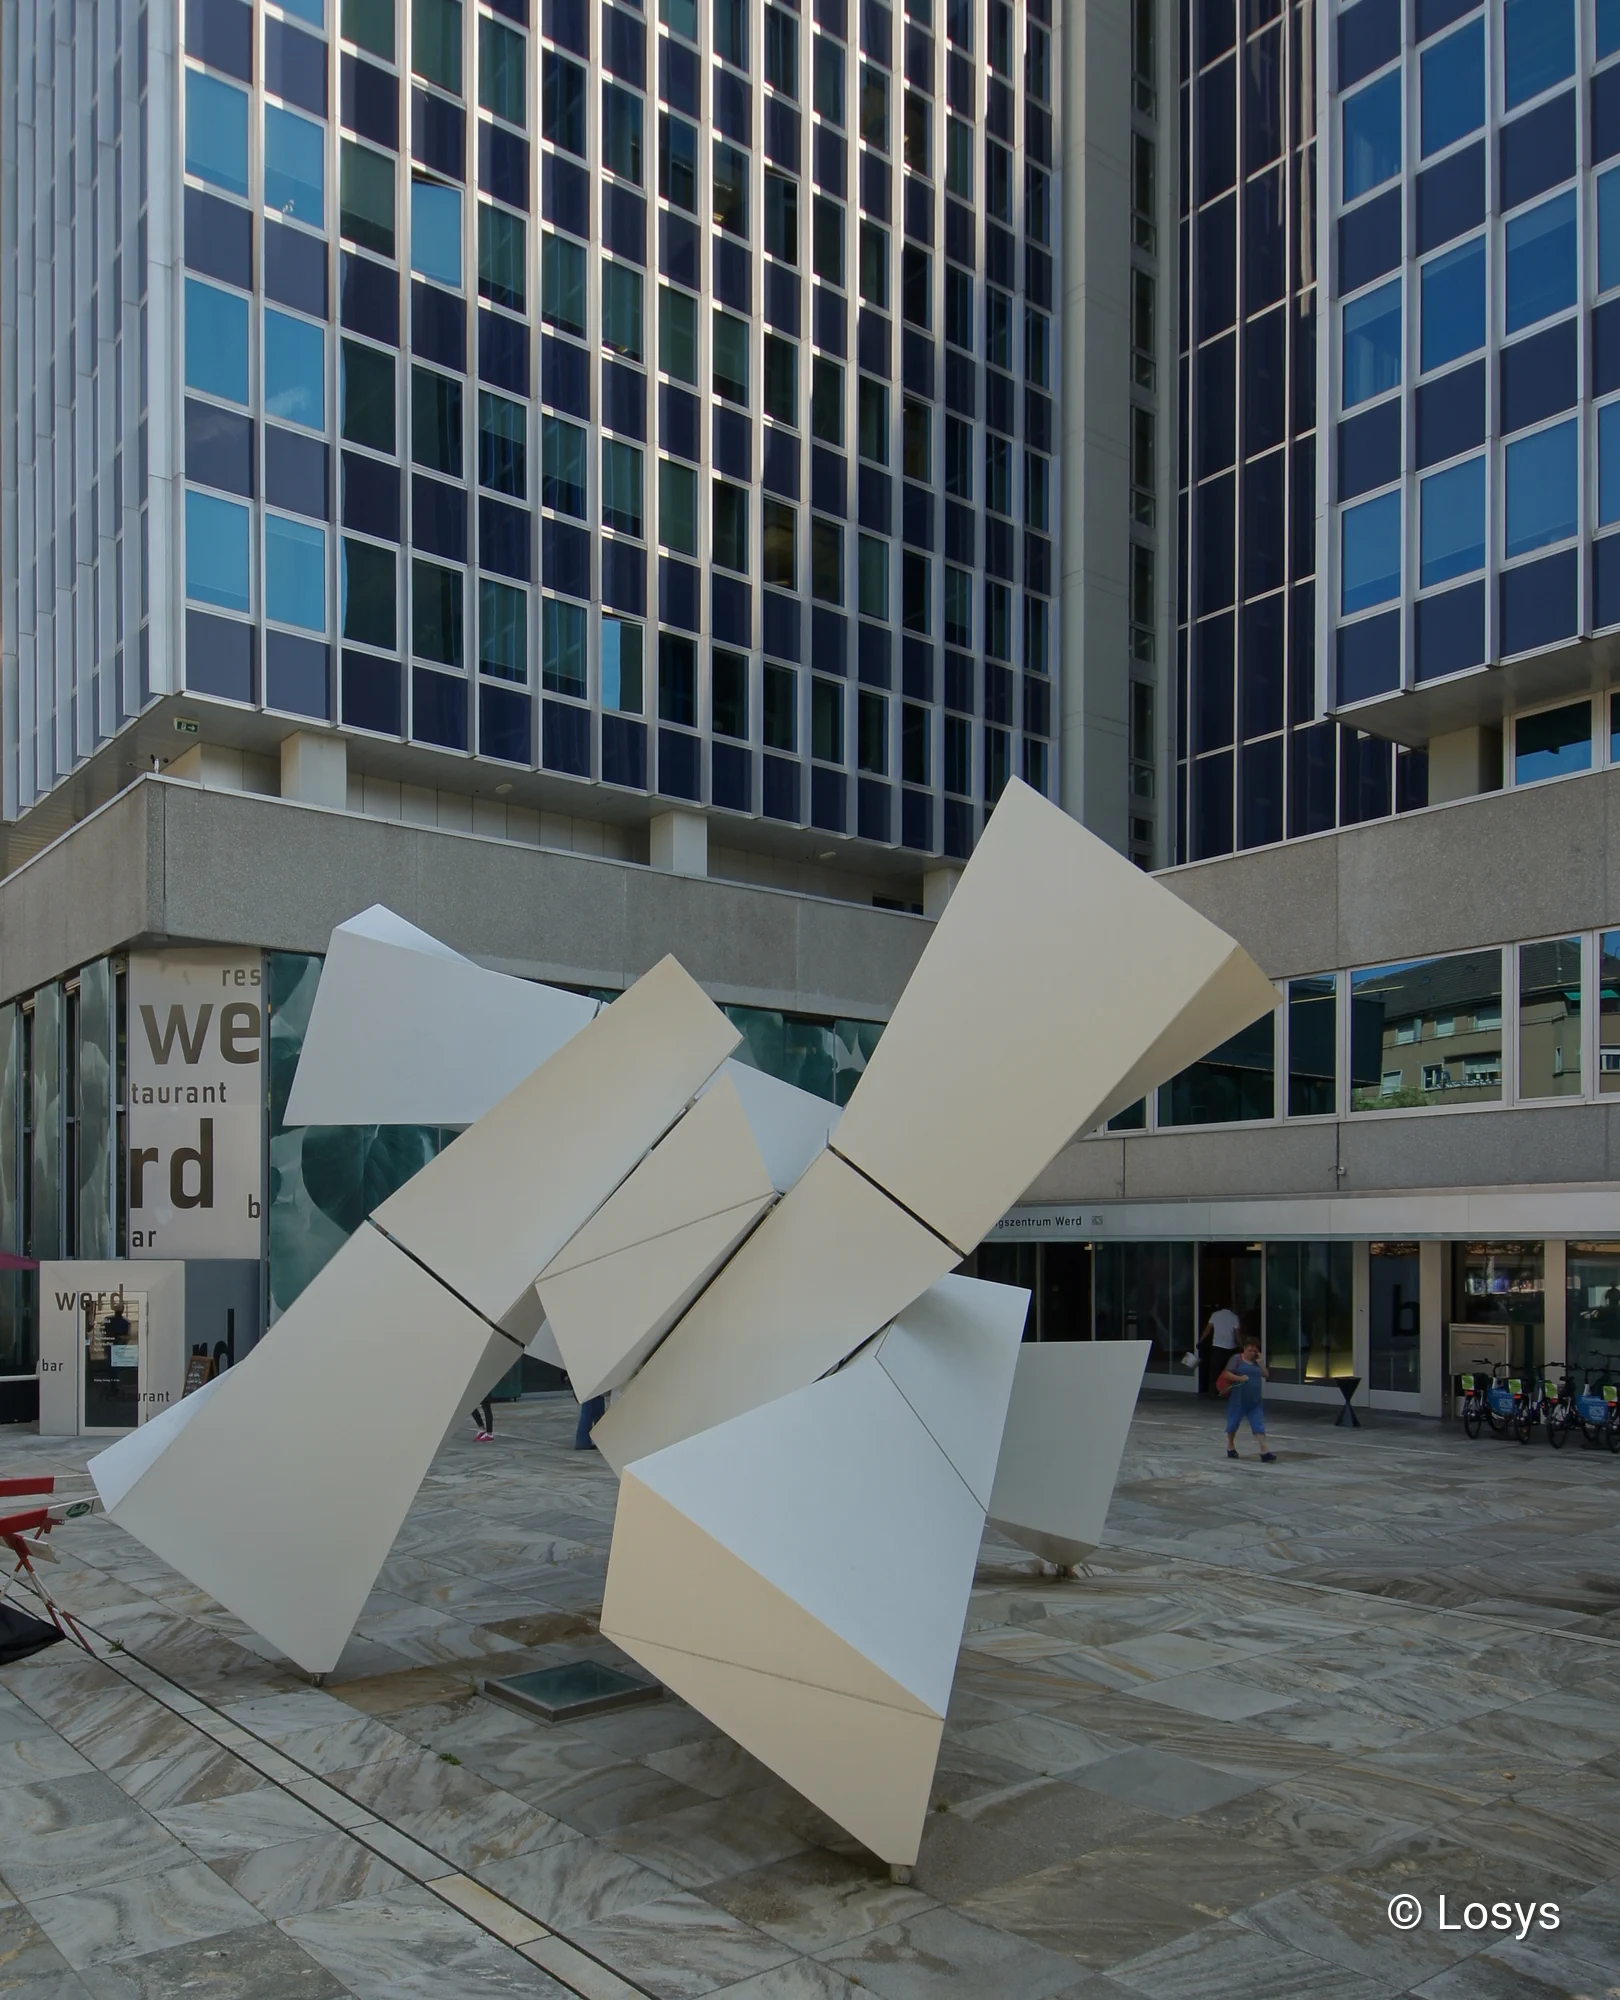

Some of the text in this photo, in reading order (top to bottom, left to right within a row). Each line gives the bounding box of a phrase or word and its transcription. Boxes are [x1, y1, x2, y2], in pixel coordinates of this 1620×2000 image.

[222, 968, 261, 986] res
[139, 1002, 260, 1064] we
[131, 1082, 227, 1104] taurant
[130, 1118, 213, 1209] rd
[248, 1194, 260, 1218] b
[1056, 1216, 1082, 1226] Werd
[132, 1230, 156, 1247] ar
[55, 1284, 124, 1311] werd
[42, 1359, 63, 1371] bar
